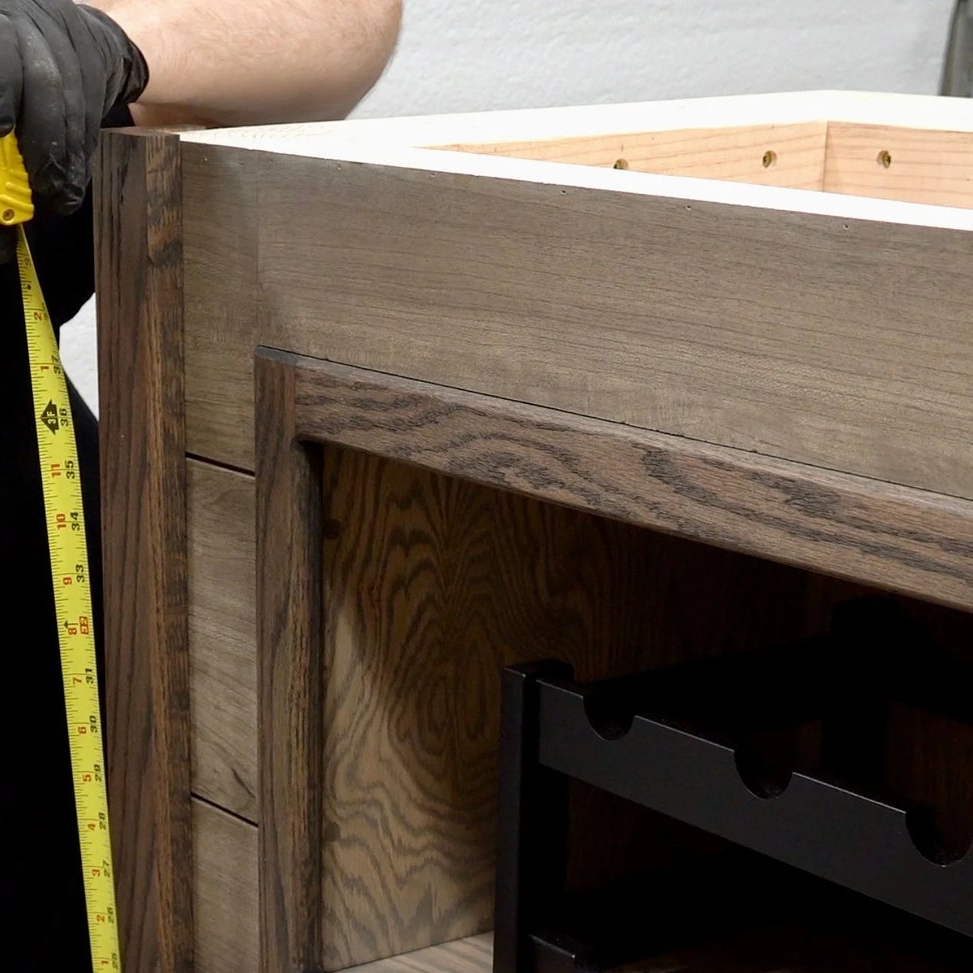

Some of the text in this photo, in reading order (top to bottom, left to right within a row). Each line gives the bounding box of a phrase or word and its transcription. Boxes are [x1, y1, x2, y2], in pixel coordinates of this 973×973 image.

[34, 312, 42, 320] 2
[52, 355, 60, 374] 37
[59, 408, 68, 426] 36
[51, 464, 60, 478] 11
[65, 461, 75, 479] 35
[56, 514, 66, 530] 10
[70, 512, 79, 530] 34
[63, 577, 72, 585] 9
[76, 564, 85, 582] 33
[68, 627, 77, 635] 8
[79, 616, 89, 635] 32
[85, 668, 94, 684] 31
[89, 715, 98, 733] 30
[83, 774, 91, 782] 5
[94, 764, 101, 782] 29
[99, 812, 106, 830] 28
[103, 860, 110, 878] 27
